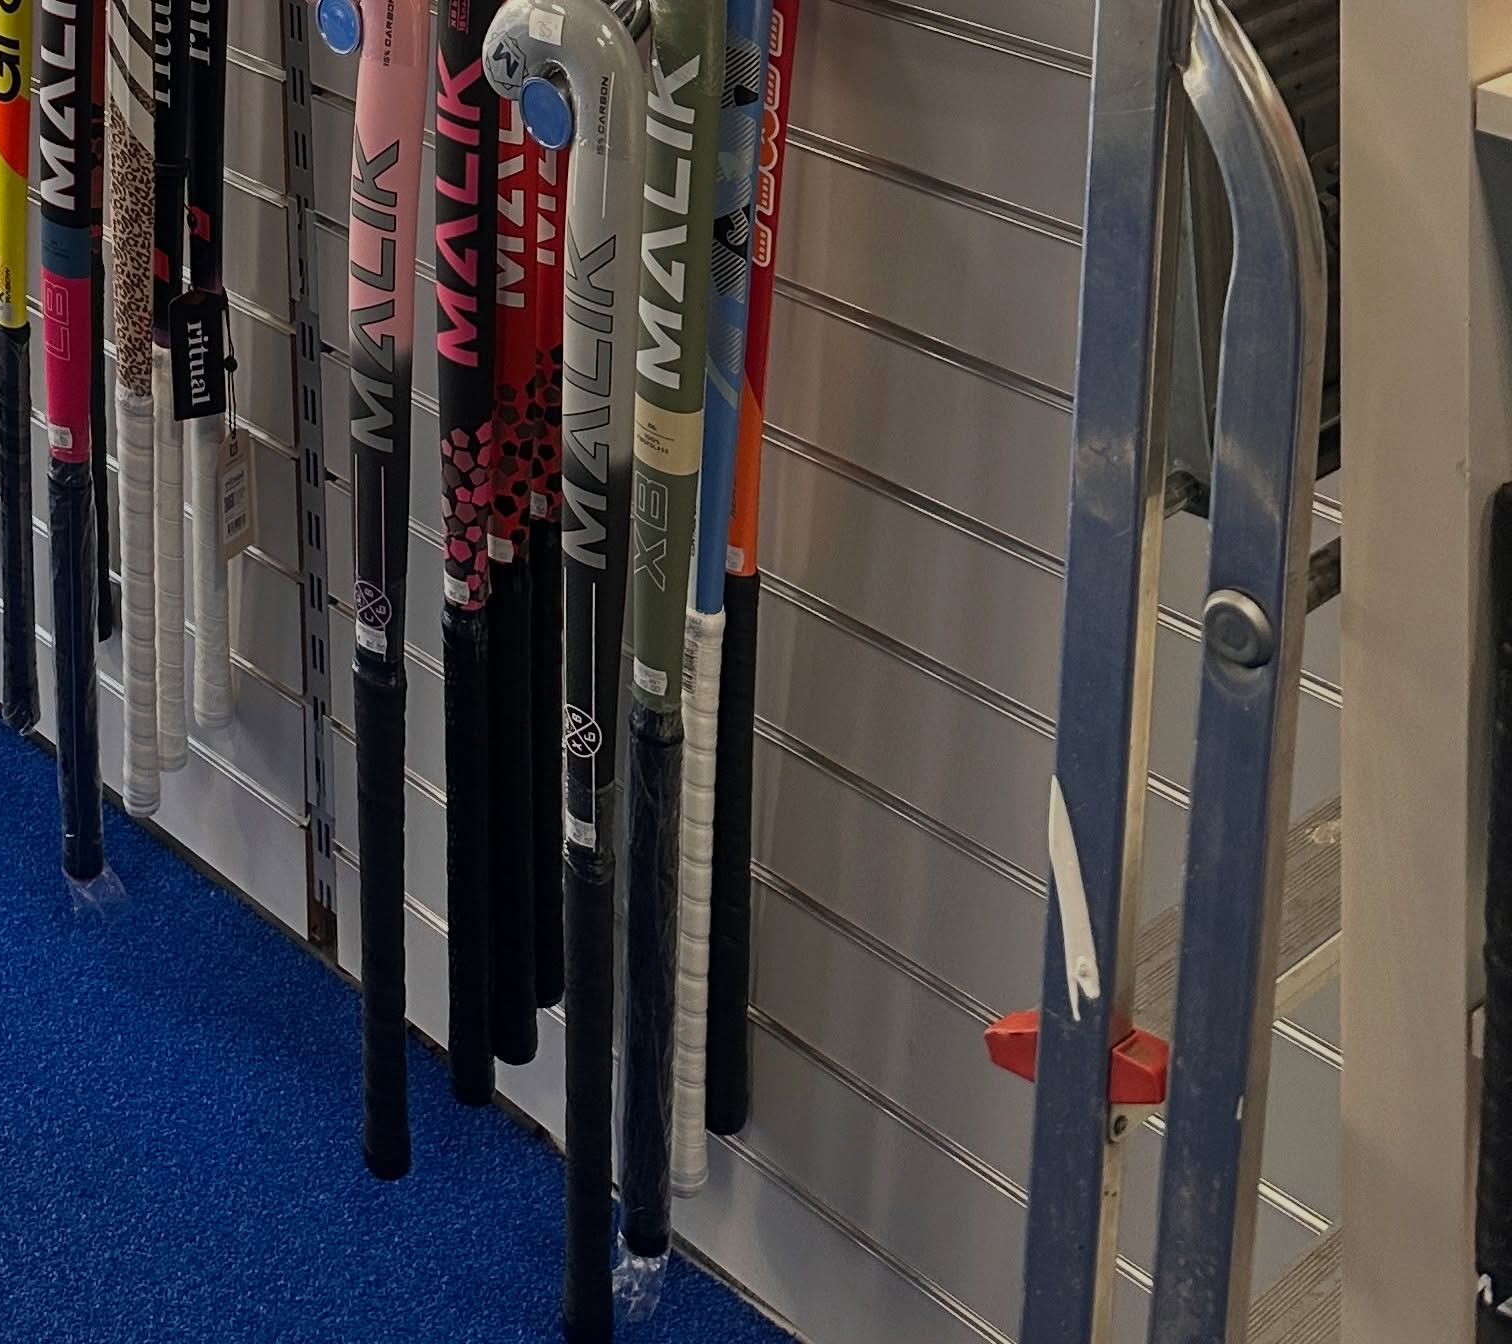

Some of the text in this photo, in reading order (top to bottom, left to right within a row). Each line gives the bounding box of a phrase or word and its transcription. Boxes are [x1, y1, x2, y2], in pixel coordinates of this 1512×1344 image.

[597, 76, 609, 135] CARBON
[436, 45, 483, 368] MALIK
[496, 100, 526, 308] MAL
[536, 150, 557, 267] MA
[636, 52, 701, 391] MALIK
[43, 278, 71, 361] LB
[186, 319, 211, 408] ritual
[349, 140, 400, 453] MALIK
[561, 233, 616, 570] MALIK
[633, 471, 668, 593] XB
